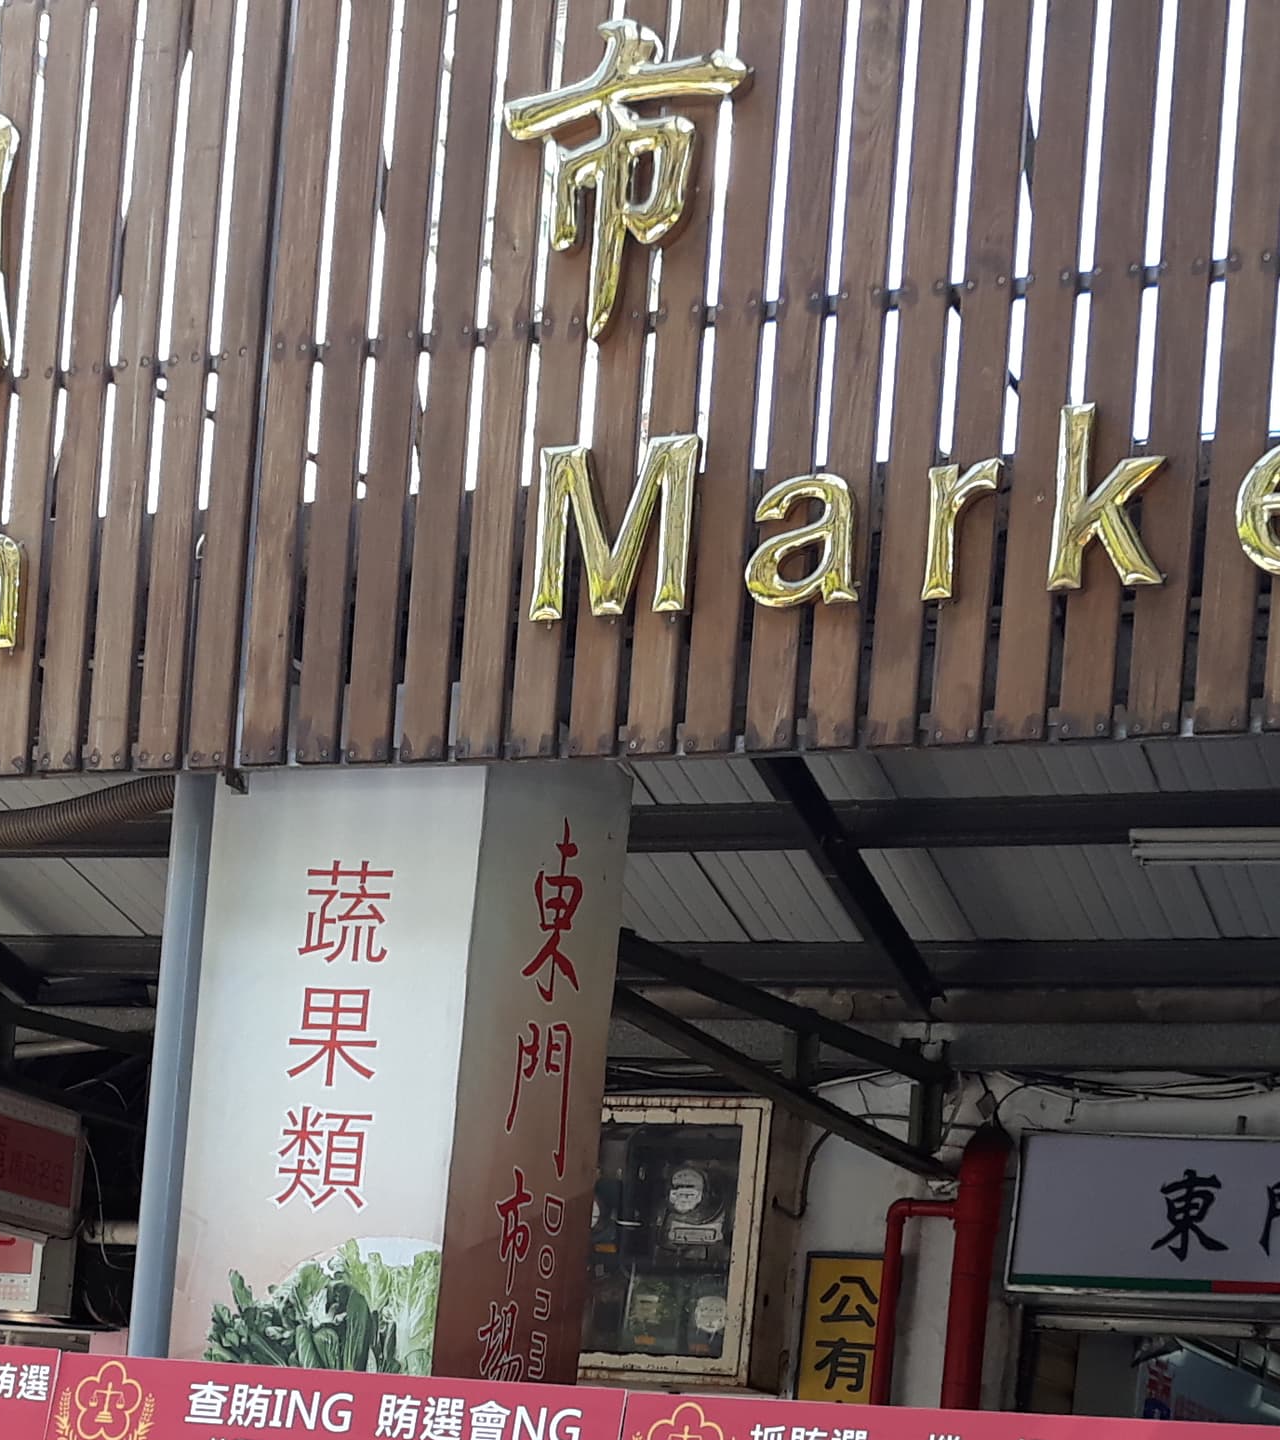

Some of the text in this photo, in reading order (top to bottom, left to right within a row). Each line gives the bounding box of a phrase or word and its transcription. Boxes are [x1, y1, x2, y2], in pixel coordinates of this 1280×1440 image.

[273, 858, 395, 1212] 蔬果類
[478, 817, 584, 1382] 東門市場
[527, 1197, 566, 1379] Donm
[815, 1275, 878, 1393] 公有
[185, 1381, 353, 1434] 查賄ING
